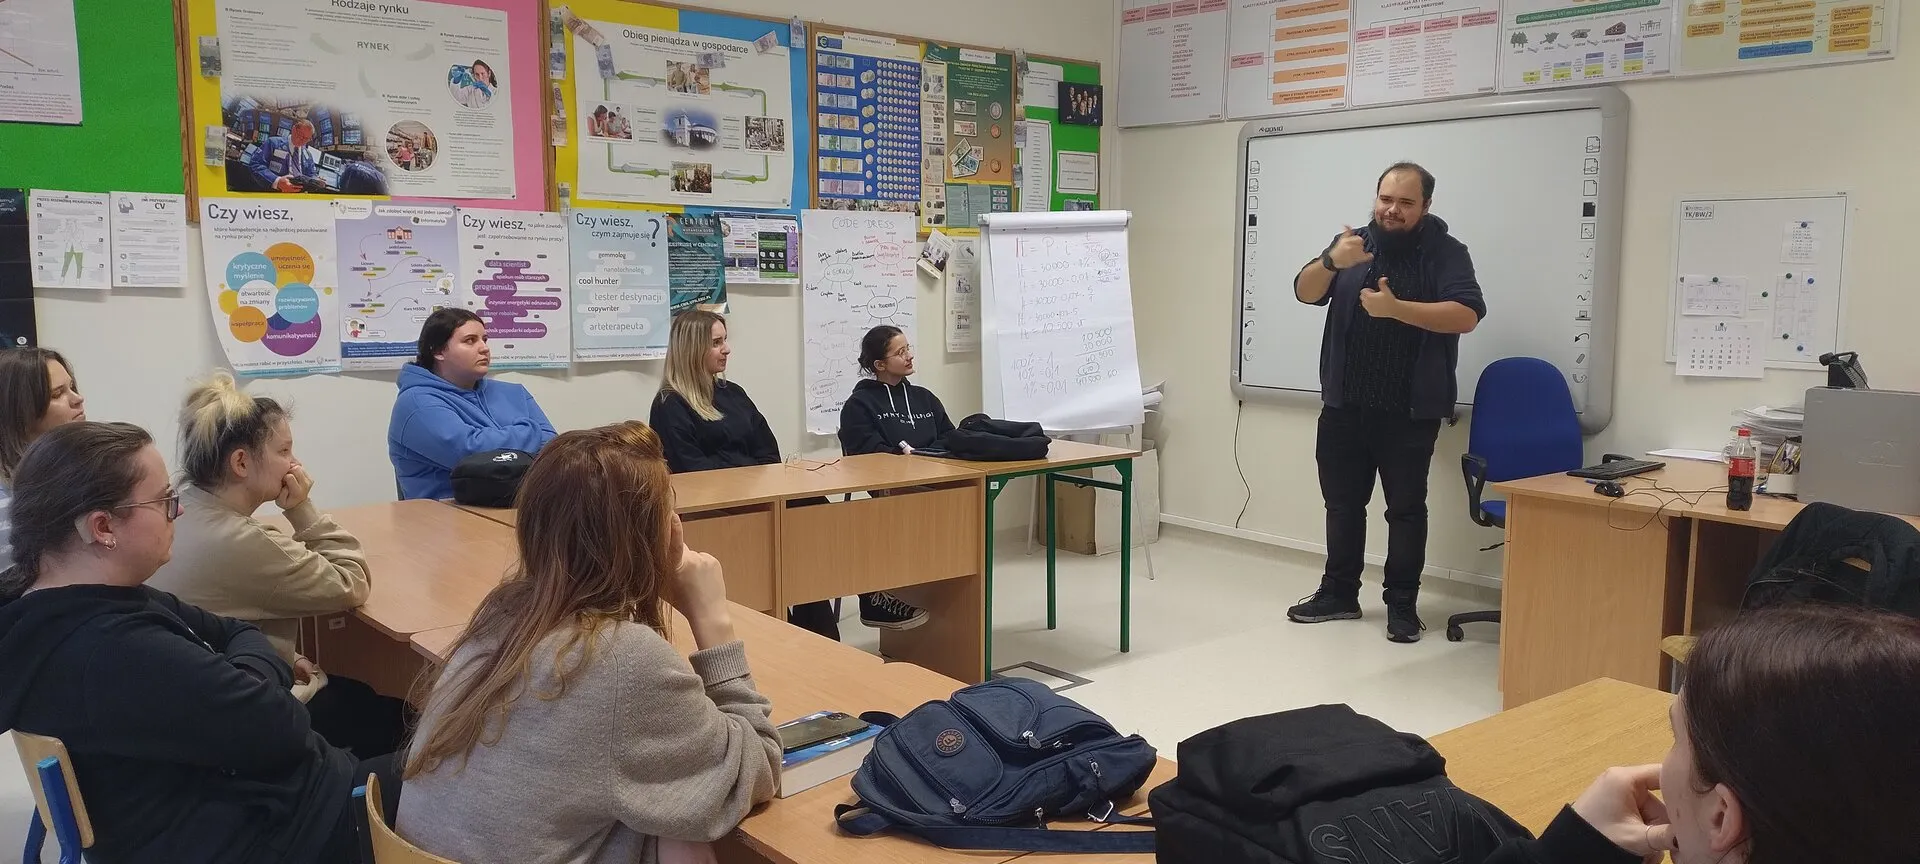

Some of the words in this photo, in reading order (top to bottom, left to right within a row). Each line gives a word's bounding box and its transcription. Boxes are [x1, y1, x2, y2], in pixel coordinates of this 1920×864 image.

[331, 0, 376, 12] Rodzaje
[378, 1, 409, 14] rynku
[357, 41, 390, 51] RYNEK
[623, 29, 649, 43] Obieg
[651, 33, 690, 47] pieniądza
[701, 40, 748, 54] gospodarce
[154, 202, 166, 210] CV
[208, 203, 238, 223] Czy
[243, 205, 293, 221] wiesz,
[463, 214, 485, 231] Czy
[489, 216, 526, 231] wiesz,
[576, 213, 597, 229] Czy
[600, 214, 633, 228] wiesz,
[680, 217, 714, 226] CENTRUM
[831, 216, 859, 229] CODE
[864, 219, 895, 229] DRESS
[592, 231, 611, 239] czym
[612, 231, 640, 240] zajmuje
[640, 232, 650, 240] się
[647, 218, 660, 247] ?
[598, 251, 626, 259] gemmolog
[232, 263, 267, 271] krytyczne
[603, 266, 645, 274] nanotechnolog
[233, 272, 265, 281] myślenie
[578, 277, 594, 285] cool
[594, 277, 619, 285] hunter
[474, 283, 516, 291] programista
[594, 292, 618, 301] tester
[620, 292, 662, 303] destynacji
[587, 304, 620, 313] copywriter
[589, 322, 644, 332] arteterapeuta
[266, 332, 317, 340] komunikatywność
